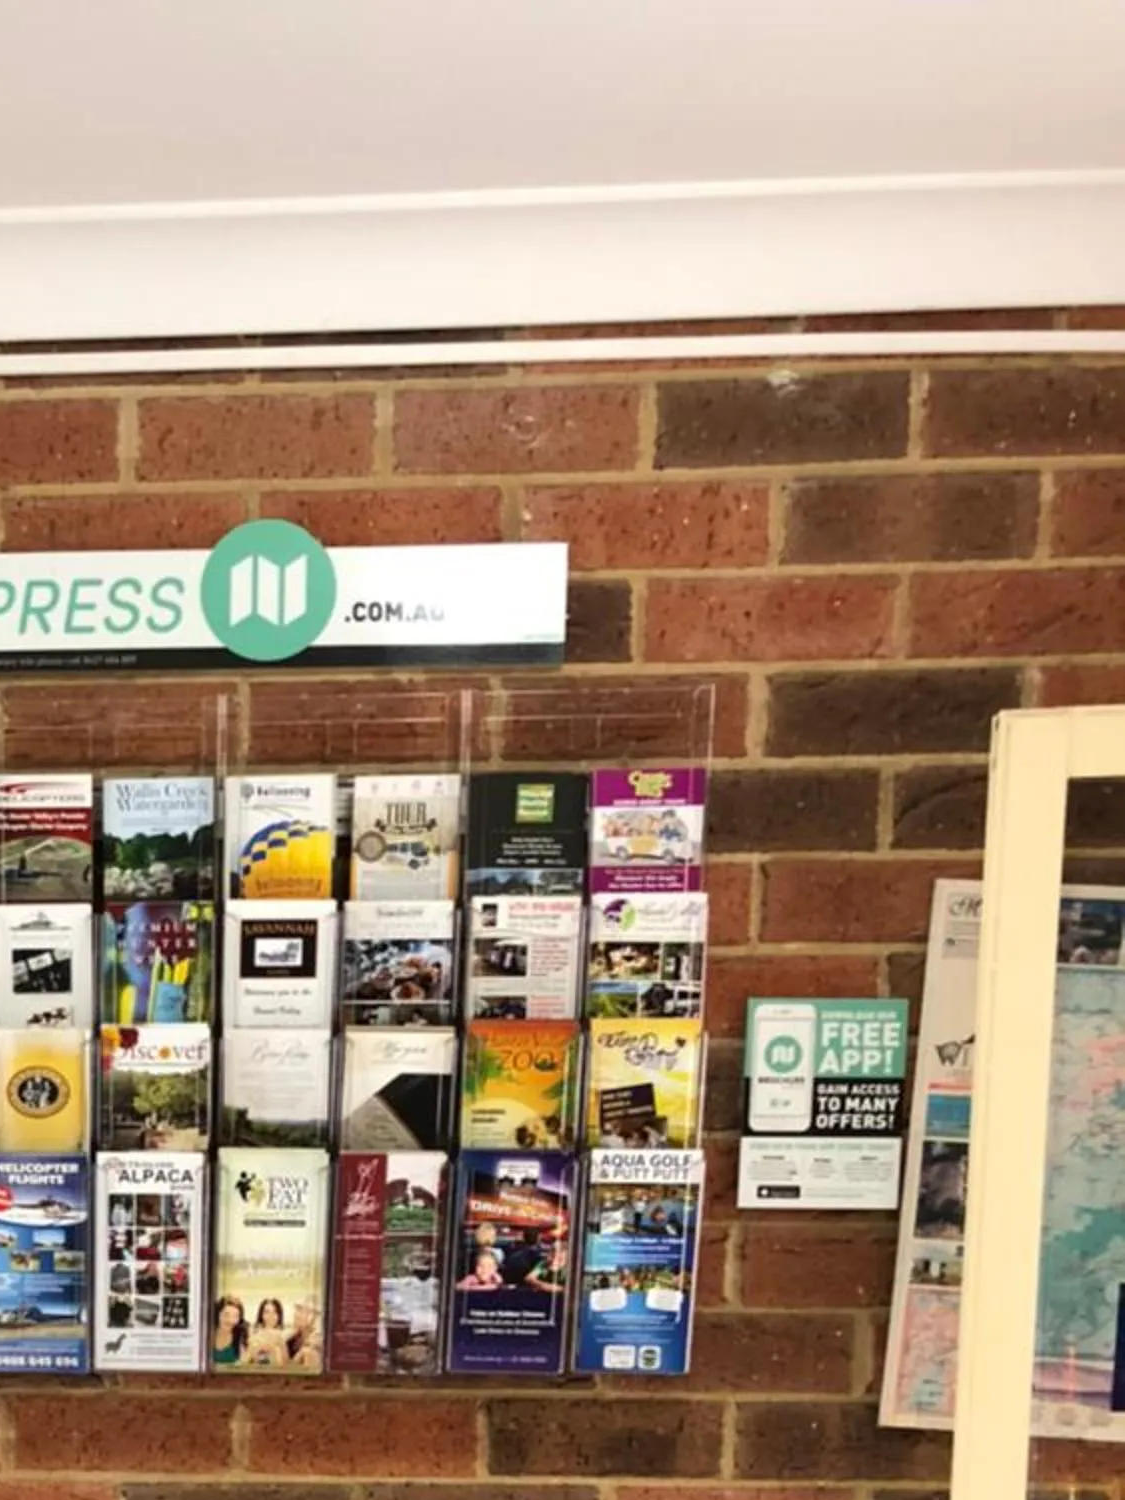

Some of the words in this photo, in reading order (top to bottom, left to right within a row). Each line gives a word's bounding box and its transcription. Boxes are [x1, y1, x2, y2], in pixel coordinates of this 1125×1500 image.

[821, 1022, 901, 1048] FREE
[818, 1049, 893, 1074] APP!
[816, 1084, 849, 1095] GAIN
[851, 1083, 900, 1095] ACCESS
[818, 1097, 840, 1112] TO
[845, 1097, 899, 1112] MANY
[816, 1114, 895, 1130] OFFERS!
[601, 1154, 646, 1168] AQUA
[649, 1154, 693, 1167] GOLF
[8, 1174, 66, 1185] FLIGHTS
[118, 1169, 194, 1183] ALPACA
